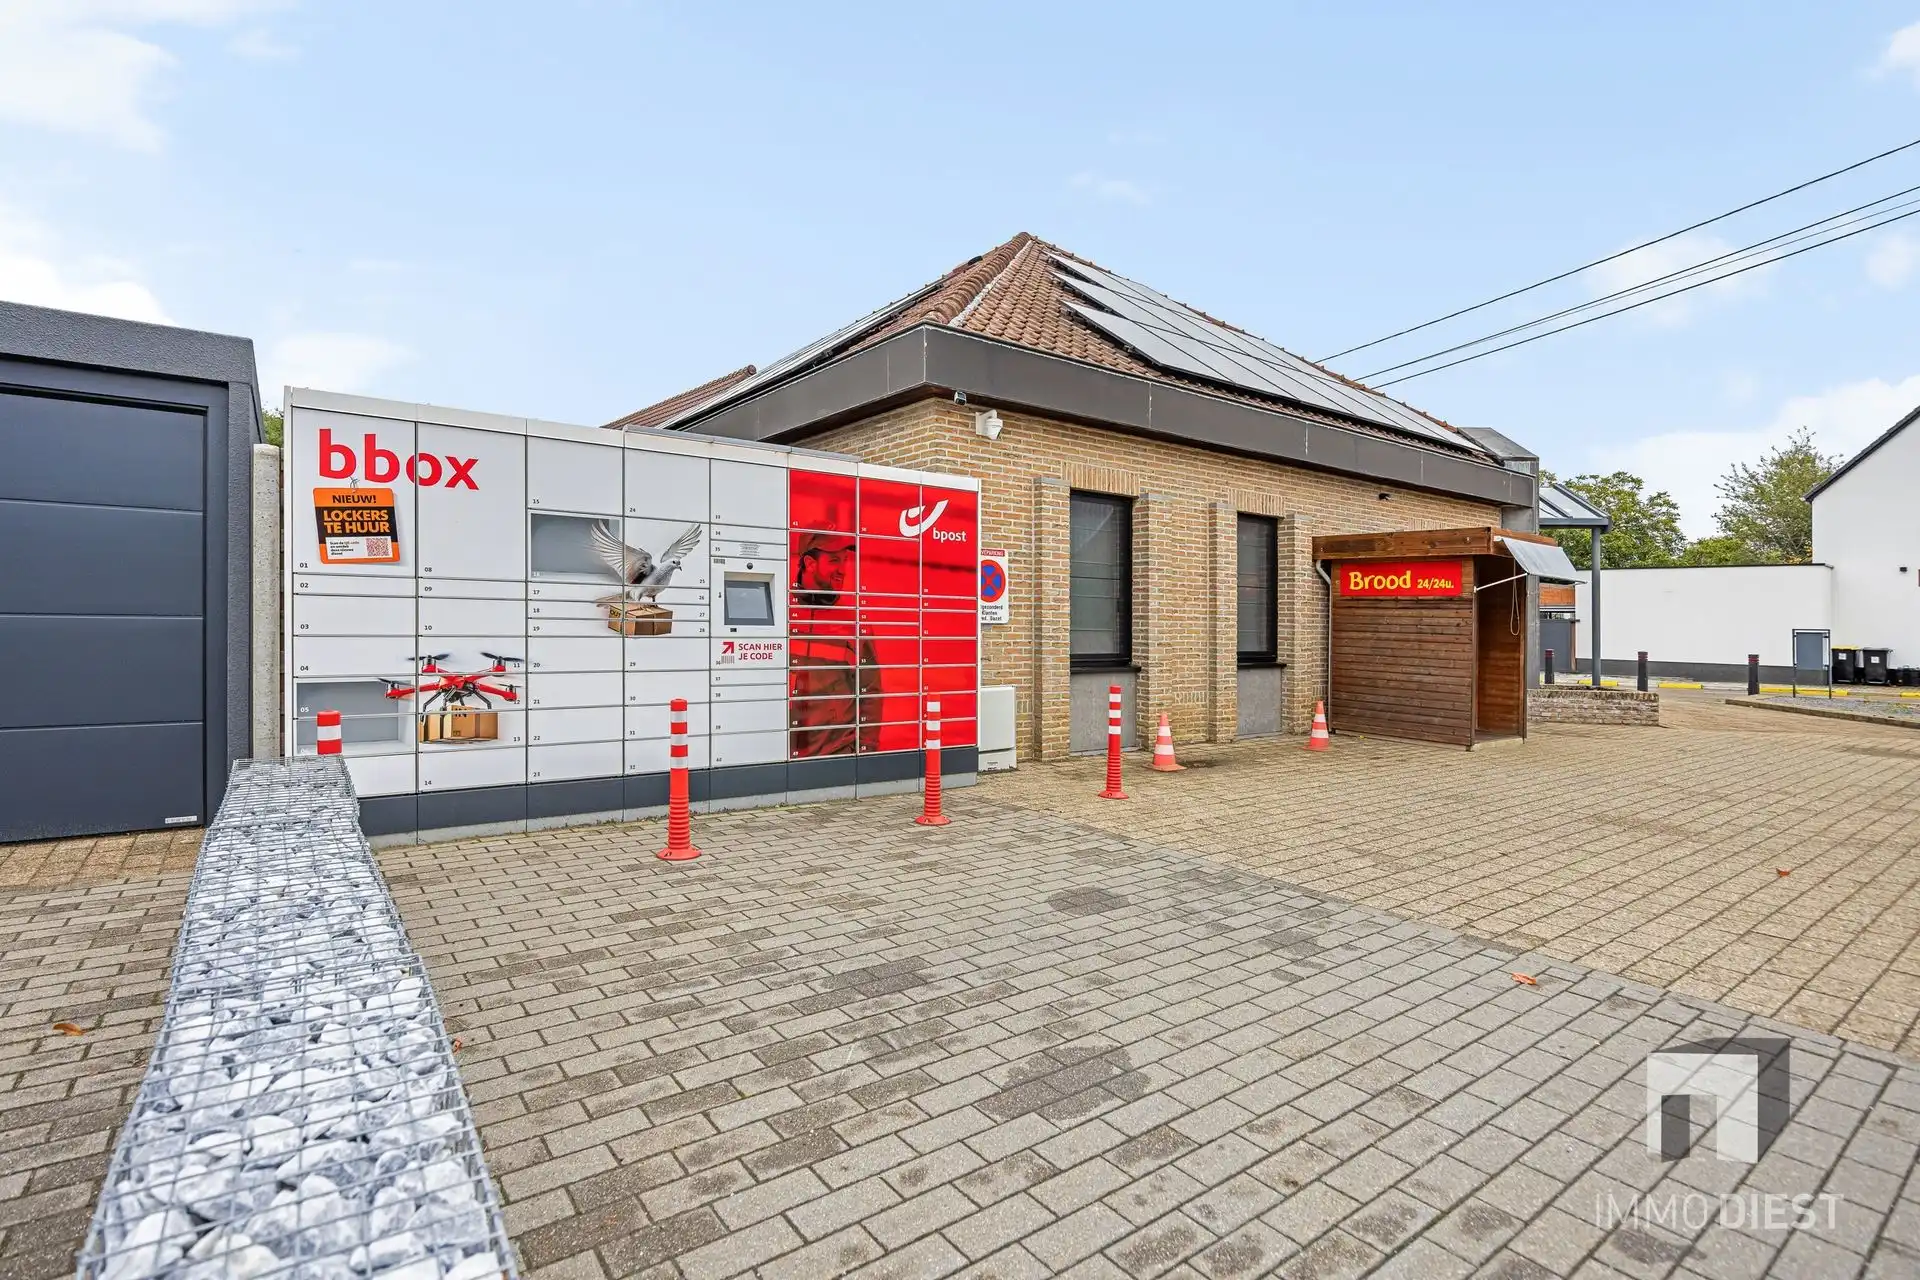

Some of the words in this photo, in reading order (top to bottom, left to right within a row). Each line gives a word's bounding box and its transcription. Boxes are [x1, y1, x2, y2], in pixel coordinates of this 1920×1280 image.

[319, 428, 479, 490] bbox
[332, 494, 376, 504] NIEUW!
[323, 510, 389, 521] LOCKERS
[324, 522, 342, 533] TE
[345, 522, 390, 533] HUUR
[933, 527, 966, 543] bpost
[1349, 570, 1411, 590] Brood
[1417, 578, 1454, 590] 24/24u.
